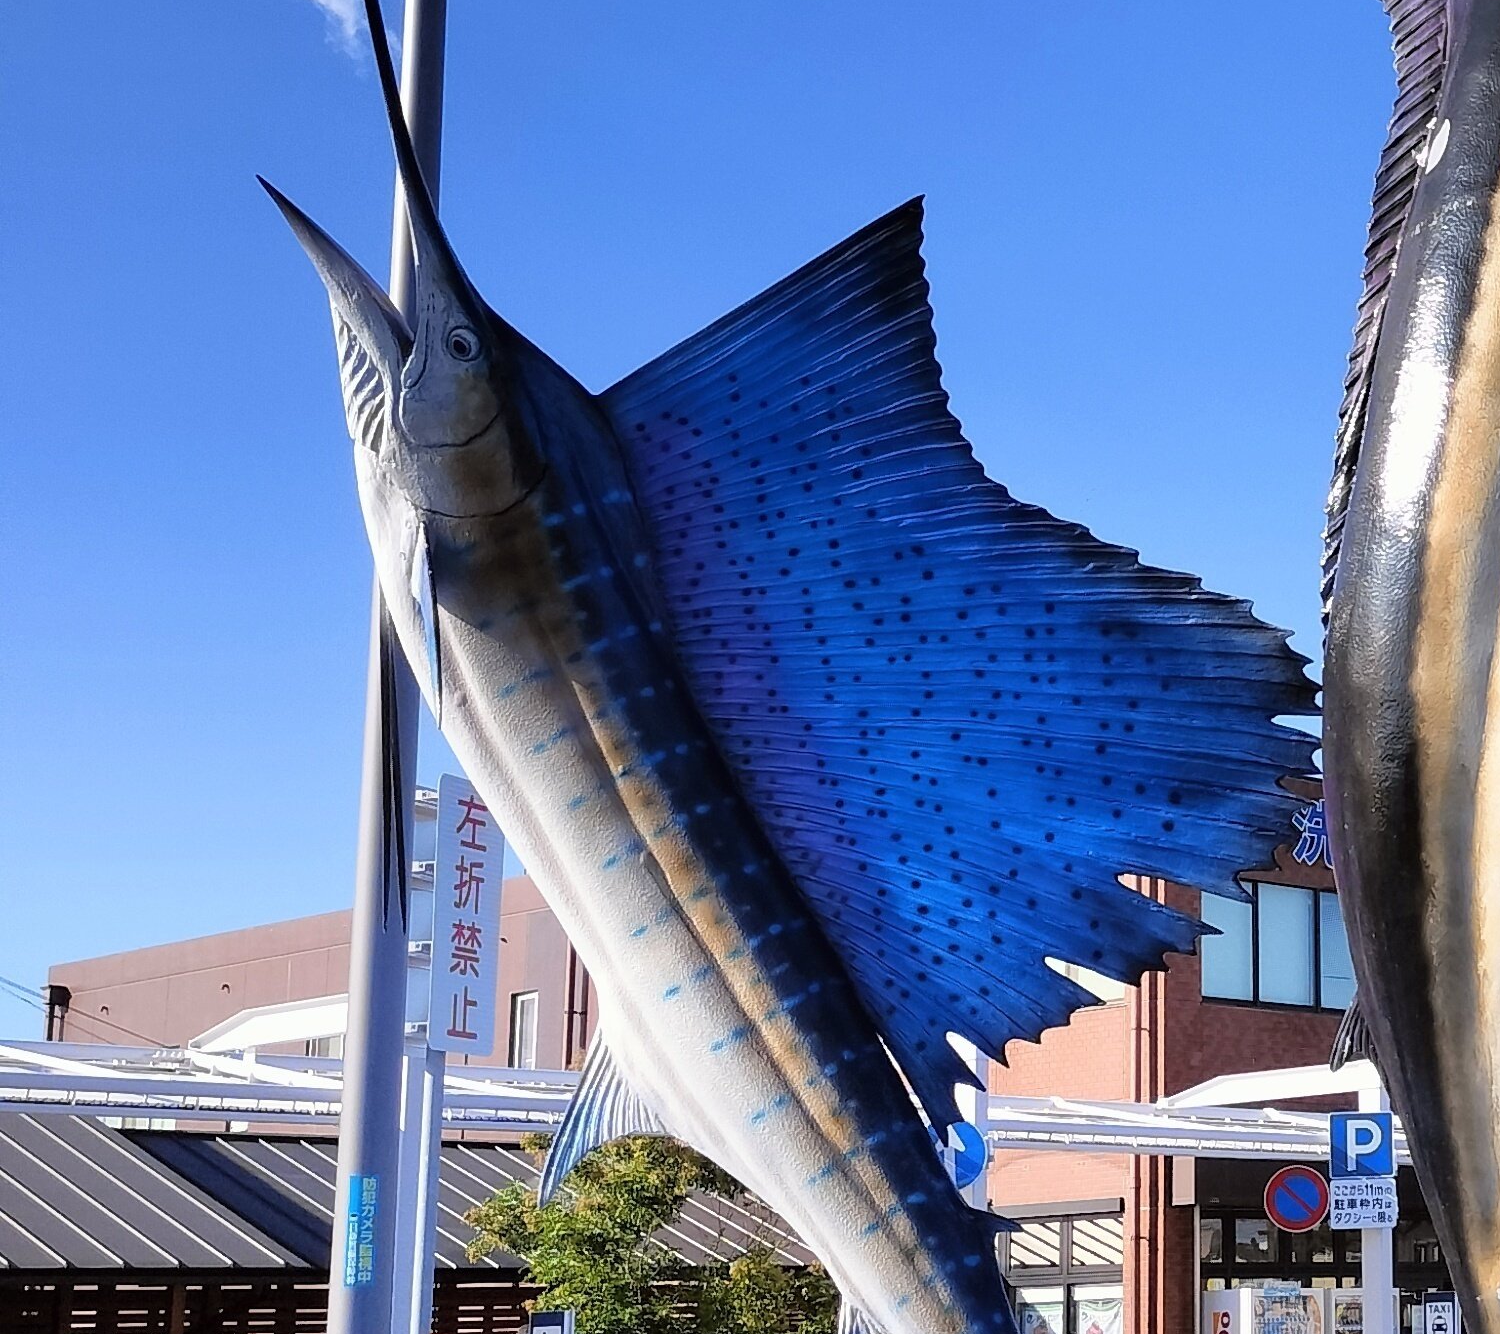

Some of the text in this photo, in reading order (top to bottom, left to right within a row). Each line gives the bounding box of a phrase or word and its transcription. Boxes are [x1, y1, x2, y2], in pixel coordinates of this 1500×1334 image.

[447, 795, 489, 1040] 左折禁止
[1346, 1119, 1381, 1171] P
[1429, 1304, 1451, 1313] TAXI
